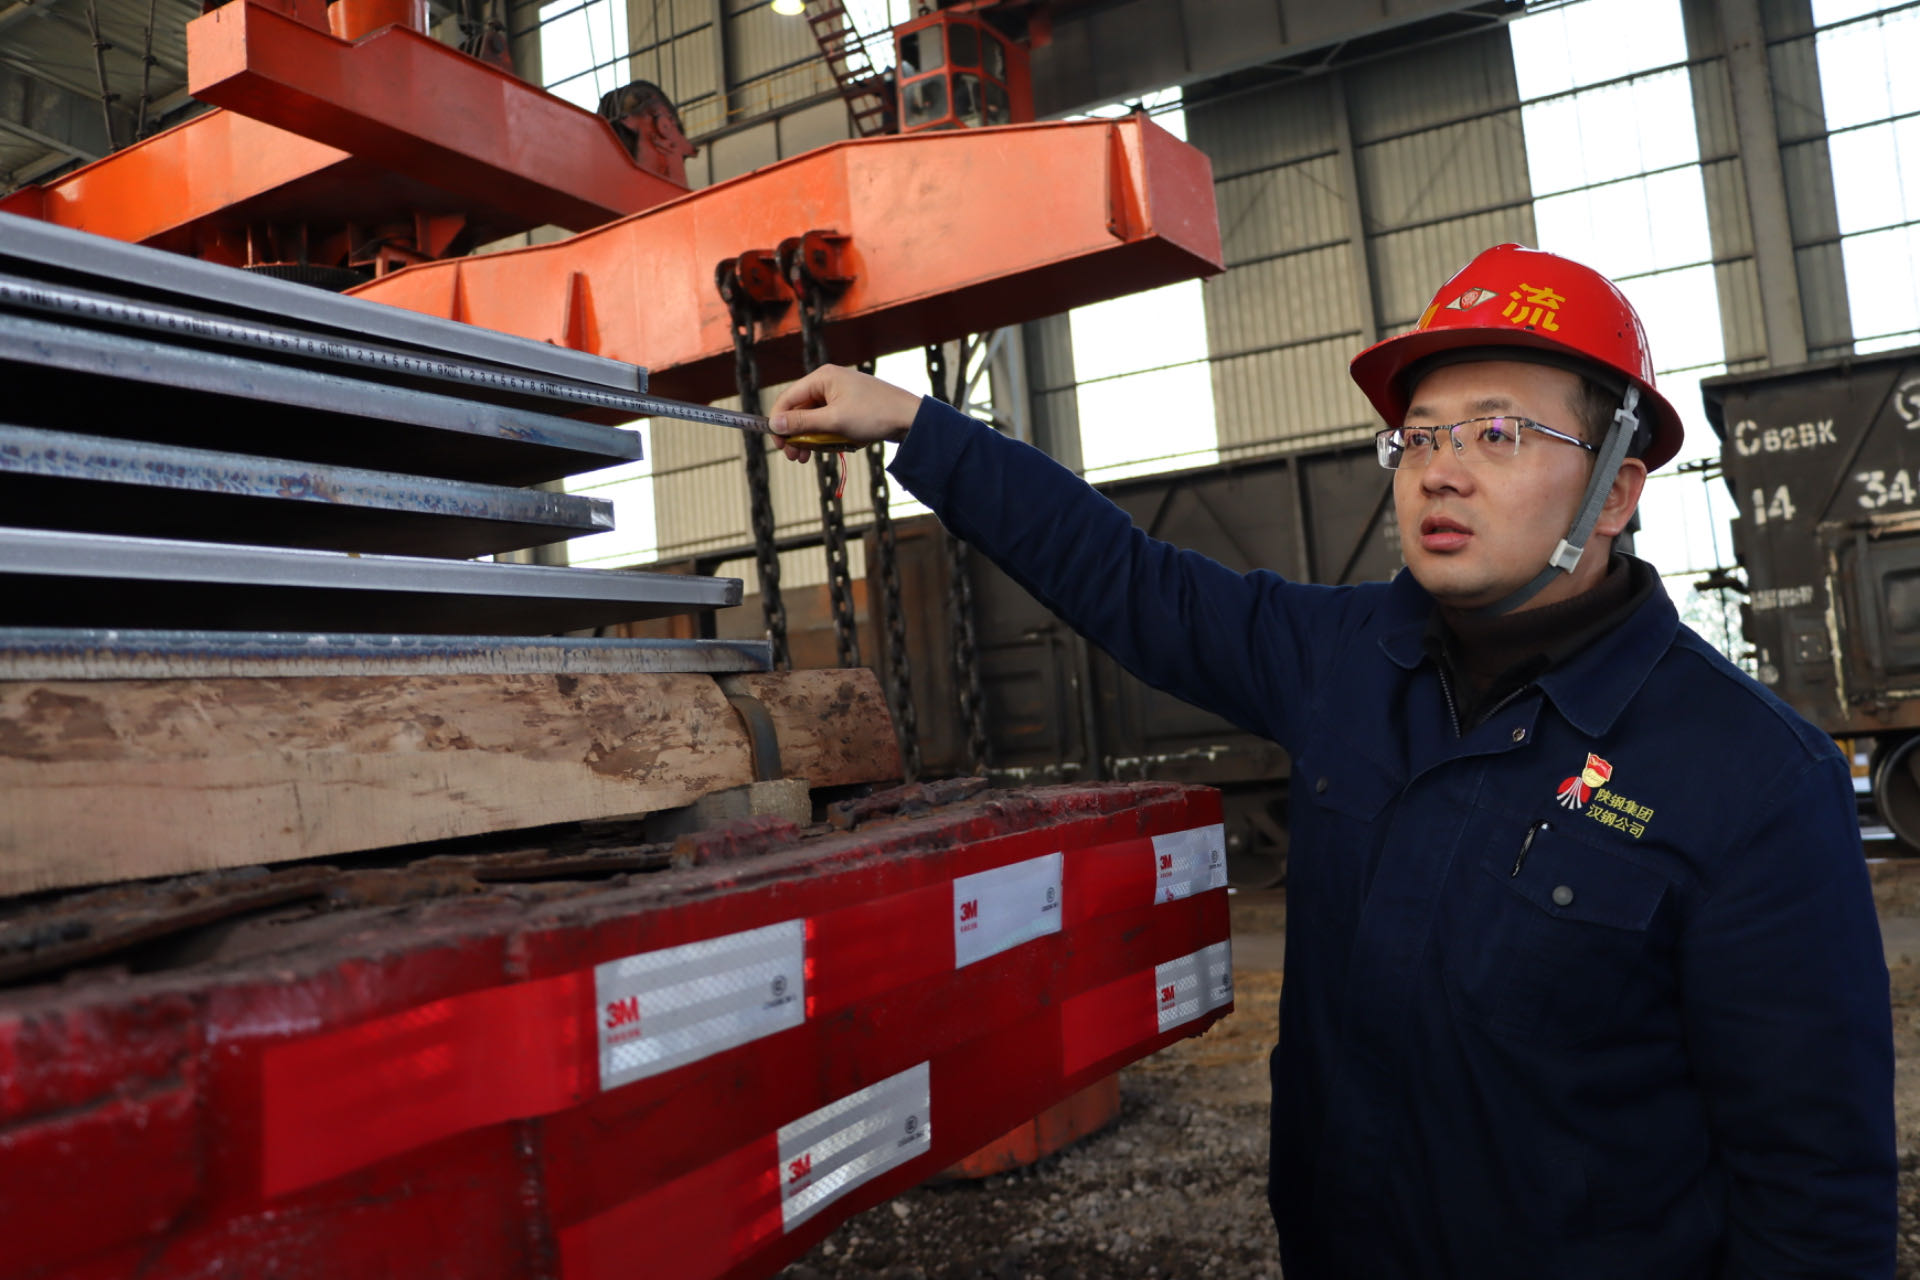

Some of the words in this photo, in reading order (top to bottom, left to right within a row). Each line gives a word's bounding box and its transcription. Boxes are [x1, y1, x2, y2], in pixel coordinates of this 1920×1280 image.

[1502, 283, 1566, 331] 流
[1735, 419, 1837, 456] C62BK
[1752, 485, 1797, 525] 14
[1857, 469, 1920, 508] 34
[1585, 804, 1645, 838] 汉钢公司
[1594, 788, 1654, 822] 陕钢集团
[1160, 854, 1173, 870] 3M
[960, 899, 978, 922] 3M
[1161, 985, 1175, 1003] 3M
[606, 995, 640, 1028] 3M
[788, 1153, 811, 1184] 3M
